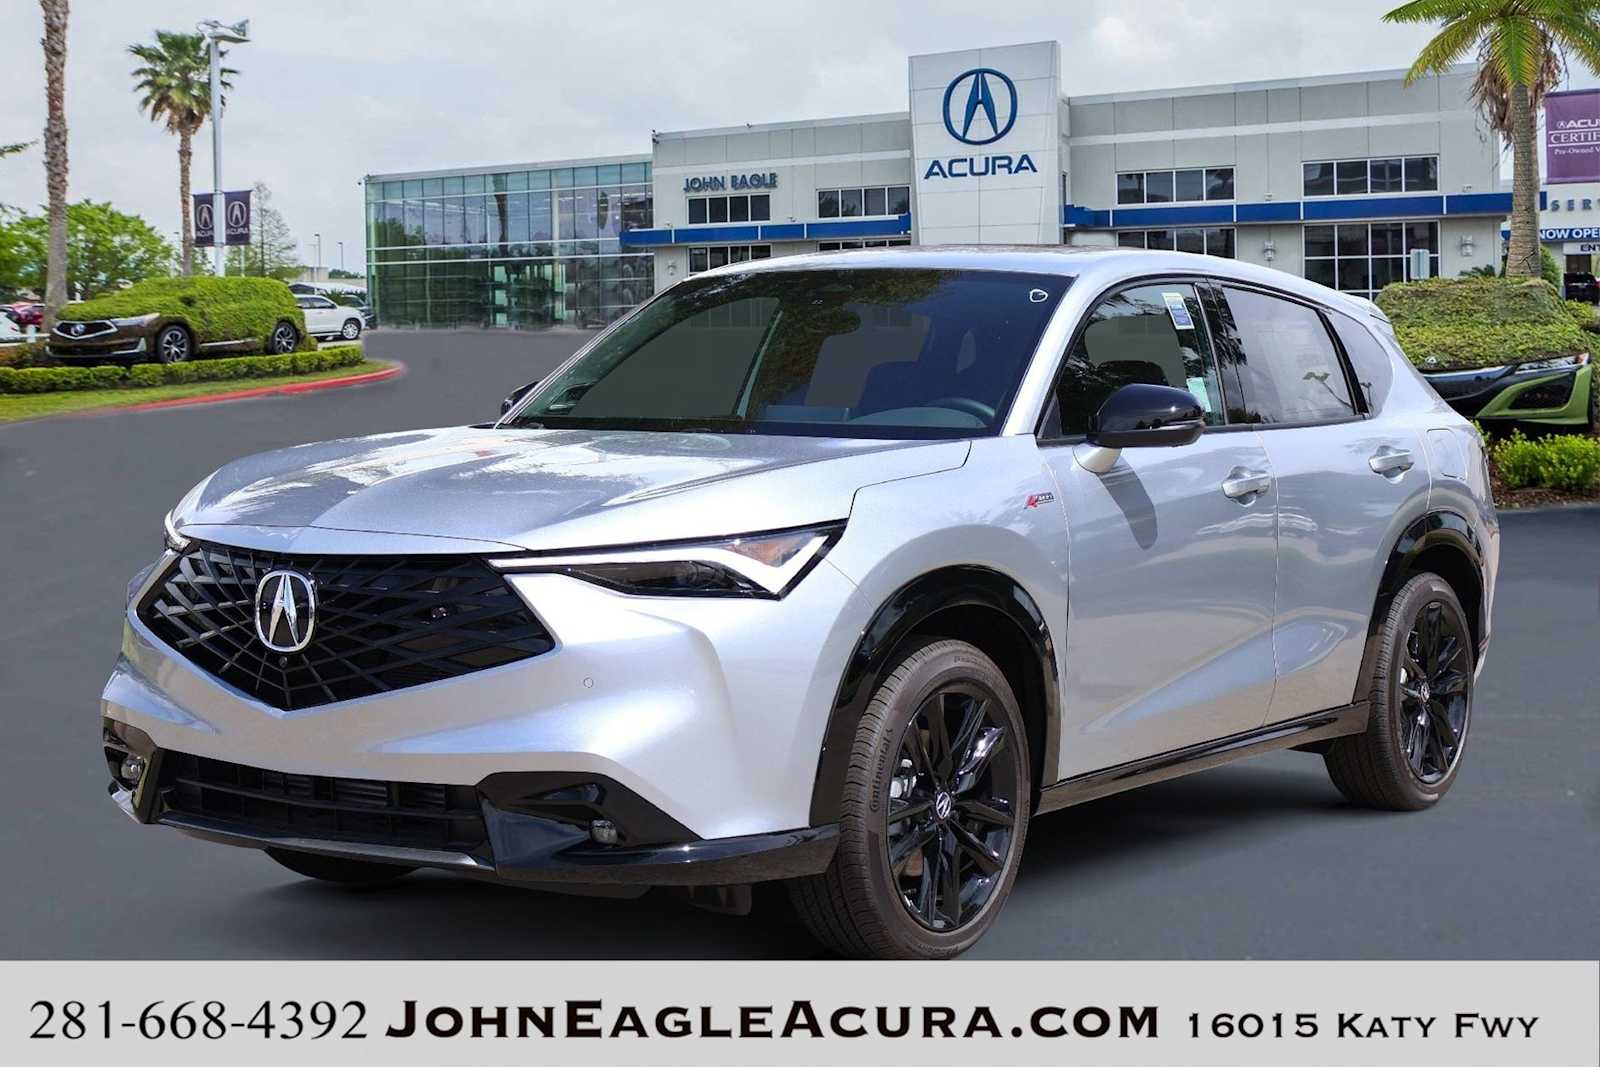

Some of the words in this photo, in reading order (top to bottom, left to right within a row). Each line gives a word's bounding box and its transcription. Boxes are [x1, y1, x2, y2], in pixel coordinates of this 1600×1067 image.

[1567, 119, 1600, 128] ACU
[1551, 132, 1600, 143] CERTIF
[924, 154, 1038, 180] ACURA
[683, 176, 726, 192] JOHN
[731, 172, 778, 190] EAGLE
[1551, 199, 1600, 211] SER
[226, 227, 249, 235] ACURA
[1540, 229, 1570, 239] NOW
[1572, 228, 1600, 238] OPE
